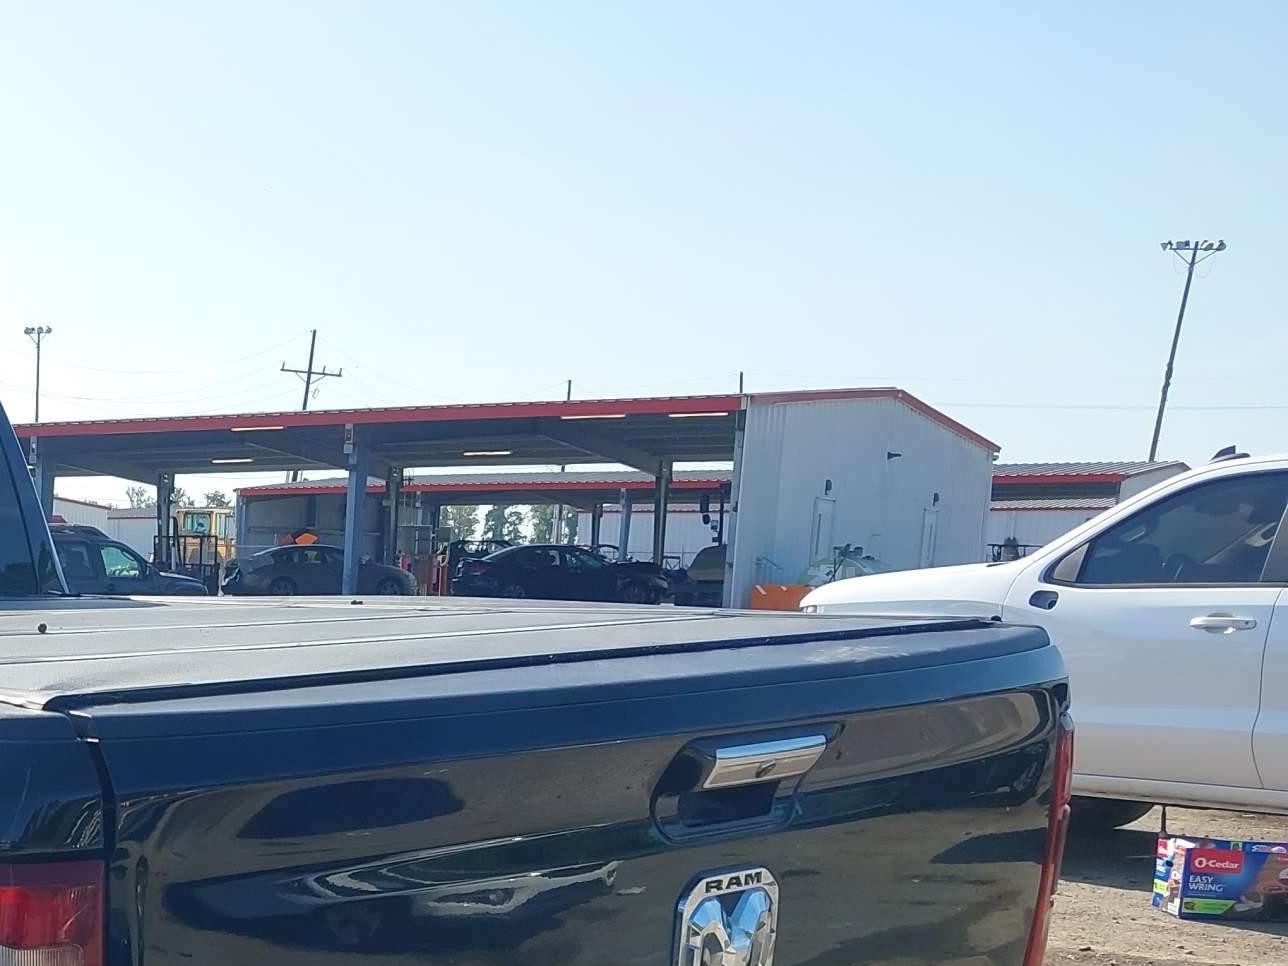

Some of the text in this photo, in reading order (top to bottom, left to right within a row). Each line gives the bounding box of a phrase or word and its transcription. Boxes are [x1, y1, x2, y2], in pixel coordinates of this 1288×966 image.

[1194, 857, 1240, 869] O-Cedar
[704, 871, 763, 894] RAM
[1188, 875, 1214, 884] EASY
[1188, 882, 1224, 892] WRING
